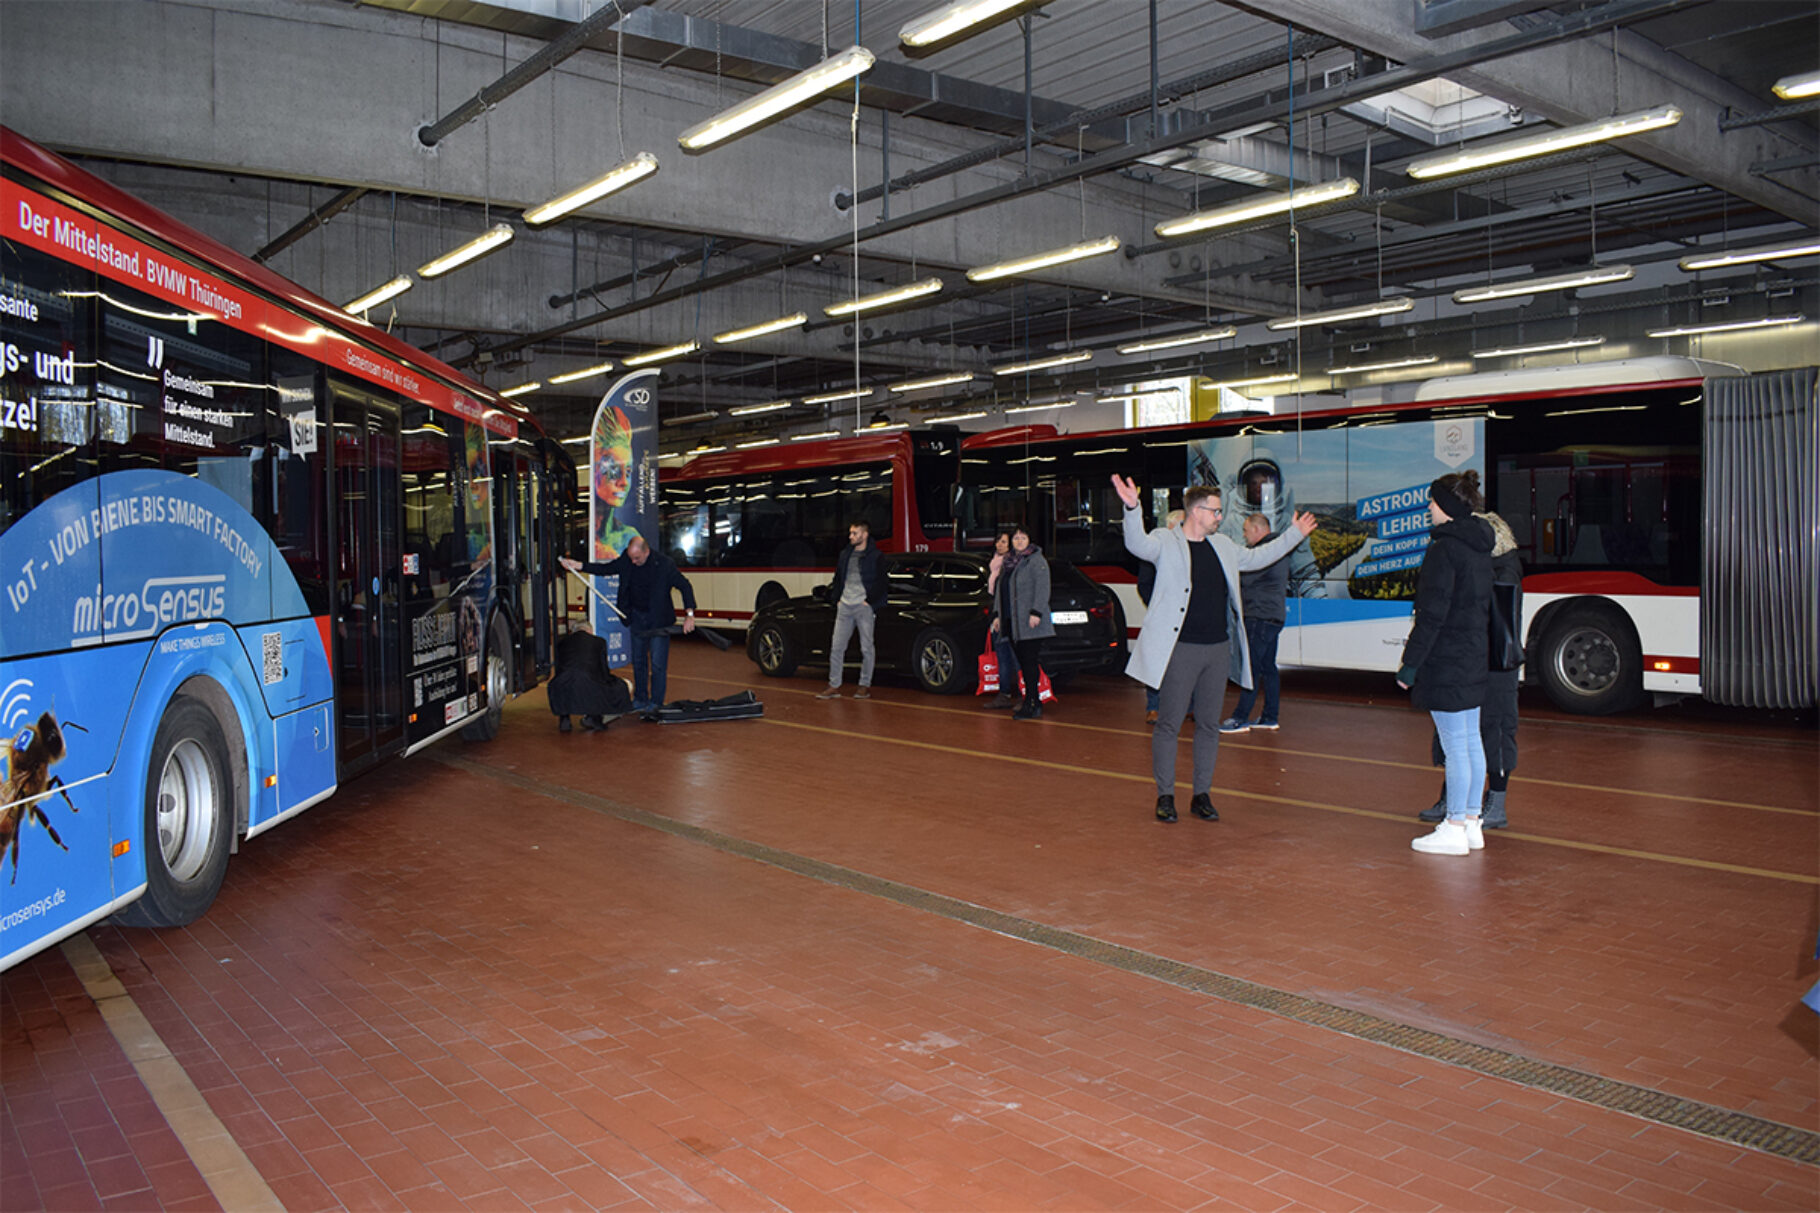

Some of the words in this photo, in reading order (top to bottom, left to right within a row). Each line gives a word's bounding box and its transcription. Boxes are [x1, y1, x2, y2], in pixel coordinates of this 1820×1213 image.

[19, 200, 50, 238] Der
[54, 217, 144, 279] Mittelstand.
[146, 258, 187, 297] BVMW
[190, 277, 242, 320] Thüringen
[0, 294, 38, 321] sante
[35, 350, 74, 385] und
[346, 348, 382, 377] Gemeinsam
[164, 368, 214, 398] Gemeinsam
[0, 396, 38, 432] ze!
[164, 395, 178, 414] für
[179, 400, 202, 421] einen
[204, 408, 234, 428] starken
[164, 422, 216, 448] Mittelstand.
[6, 559, 38, 613] IoT
[49, 516, 91, 566] VON
[93, 496, 140, 540] BIENE
[143, 495, 166, 523] BIS
[168, 497, 214, 535] SMART
[213, 515, 263, 579] FACTORY
[915, 544, 929, 553] 179
[1373, 544, 1394, 555] DEIN
[1395, 539, 1418, 551] KOPF
[1358, 564, 1378, 575] DEIN
[1380, 559, 1402, 570] HERZ
[1404, 555, 1422, 566] AUF
[160, 639, 179, 654] MAKE
[179, 636, 200, 651] THINGS
[201, 632, 226, 648] WIRELESS
